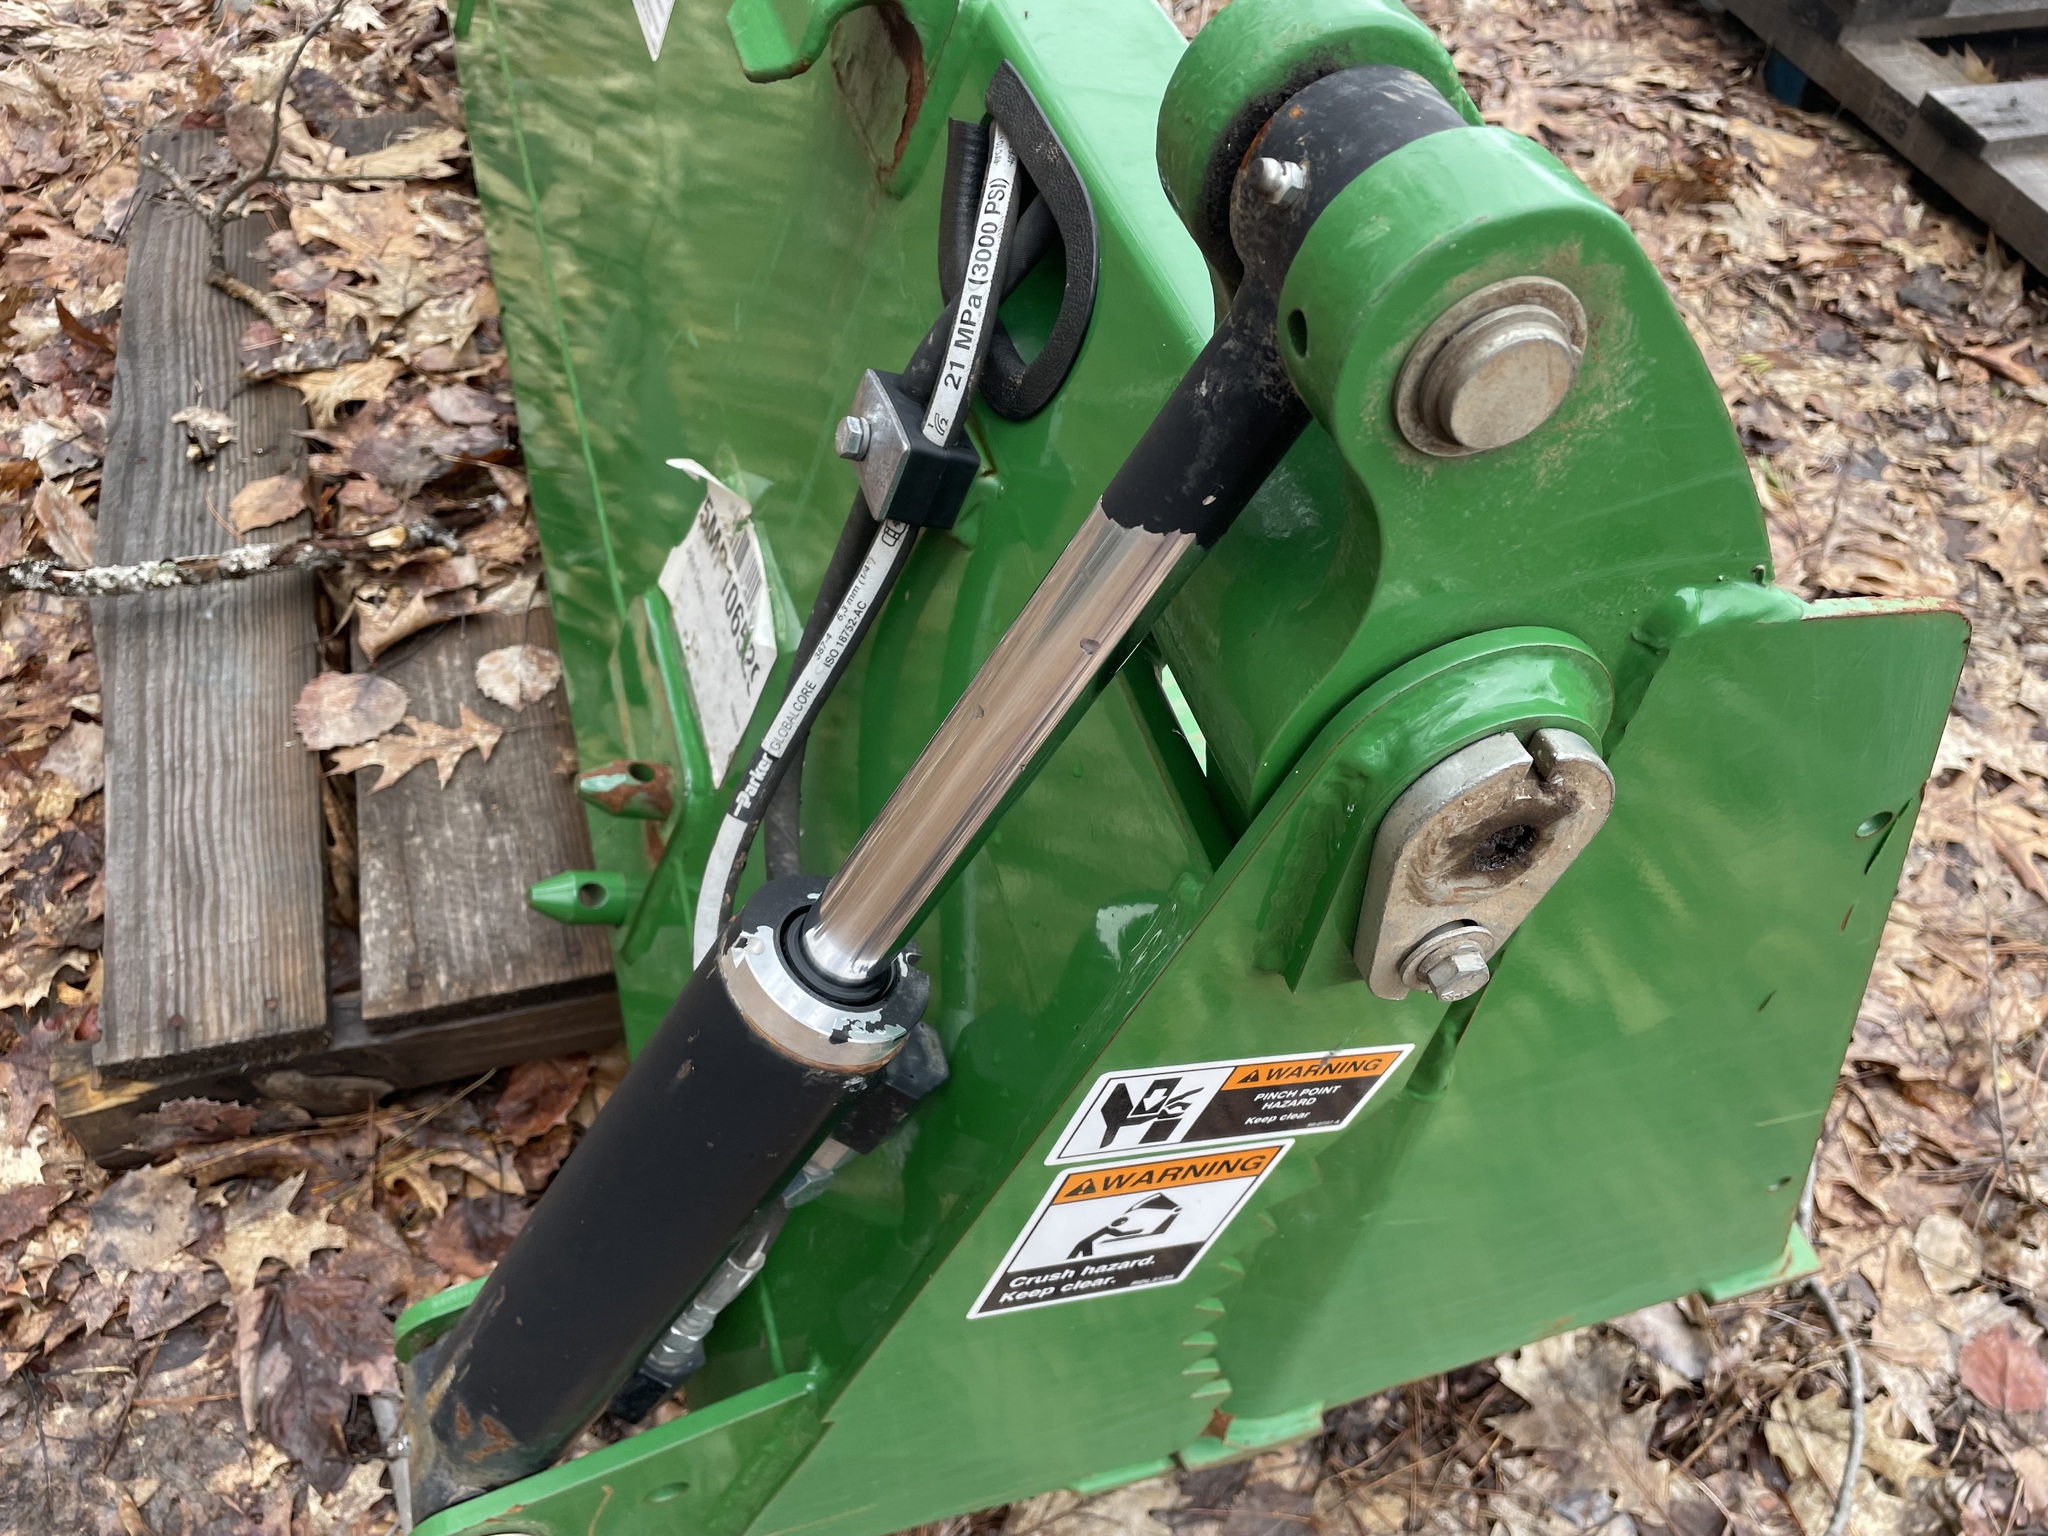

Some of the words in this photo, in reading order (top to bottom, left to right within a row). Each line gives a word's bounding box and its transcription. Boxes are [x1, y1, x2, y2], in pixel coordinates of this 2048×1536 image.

[984, 178, 1010, 215] PSI)
[968, 222, 998, 285] (3000
[954, 294, 983, 351] MPa
[944, 360, 965, 391] 21
[814, 633, 832, 660] 387-4
[848, 586, 860, 605] mm
[823, 649, 839, 668] ISO
[836, 601, 867, 647] 18752-AC
[733, 752, 774, 817] Parker
[770, 680, 817, 751] GLOBALCORE
[1266, 1058, 1383, 1081] WARNING
[1254, 1089, 1298, 1102] PINCH
[1299, 1085, 1342, 1097] POINT
[1261, 1097, 1317, 1110] HAZARD
[1244, 1115, 1277, 1126] Keep
[1279, 1111, 1311, 1122] clear
[1101, 1155, 1266, 1191] WARNING
[1009, 1268, 1076, 1288] Crush
[1080, 1255, 1156, 1277] hazard.
[998, 1285, 1055, 1303] Keep
[1060, 1275, 1116, 1293] clear.
